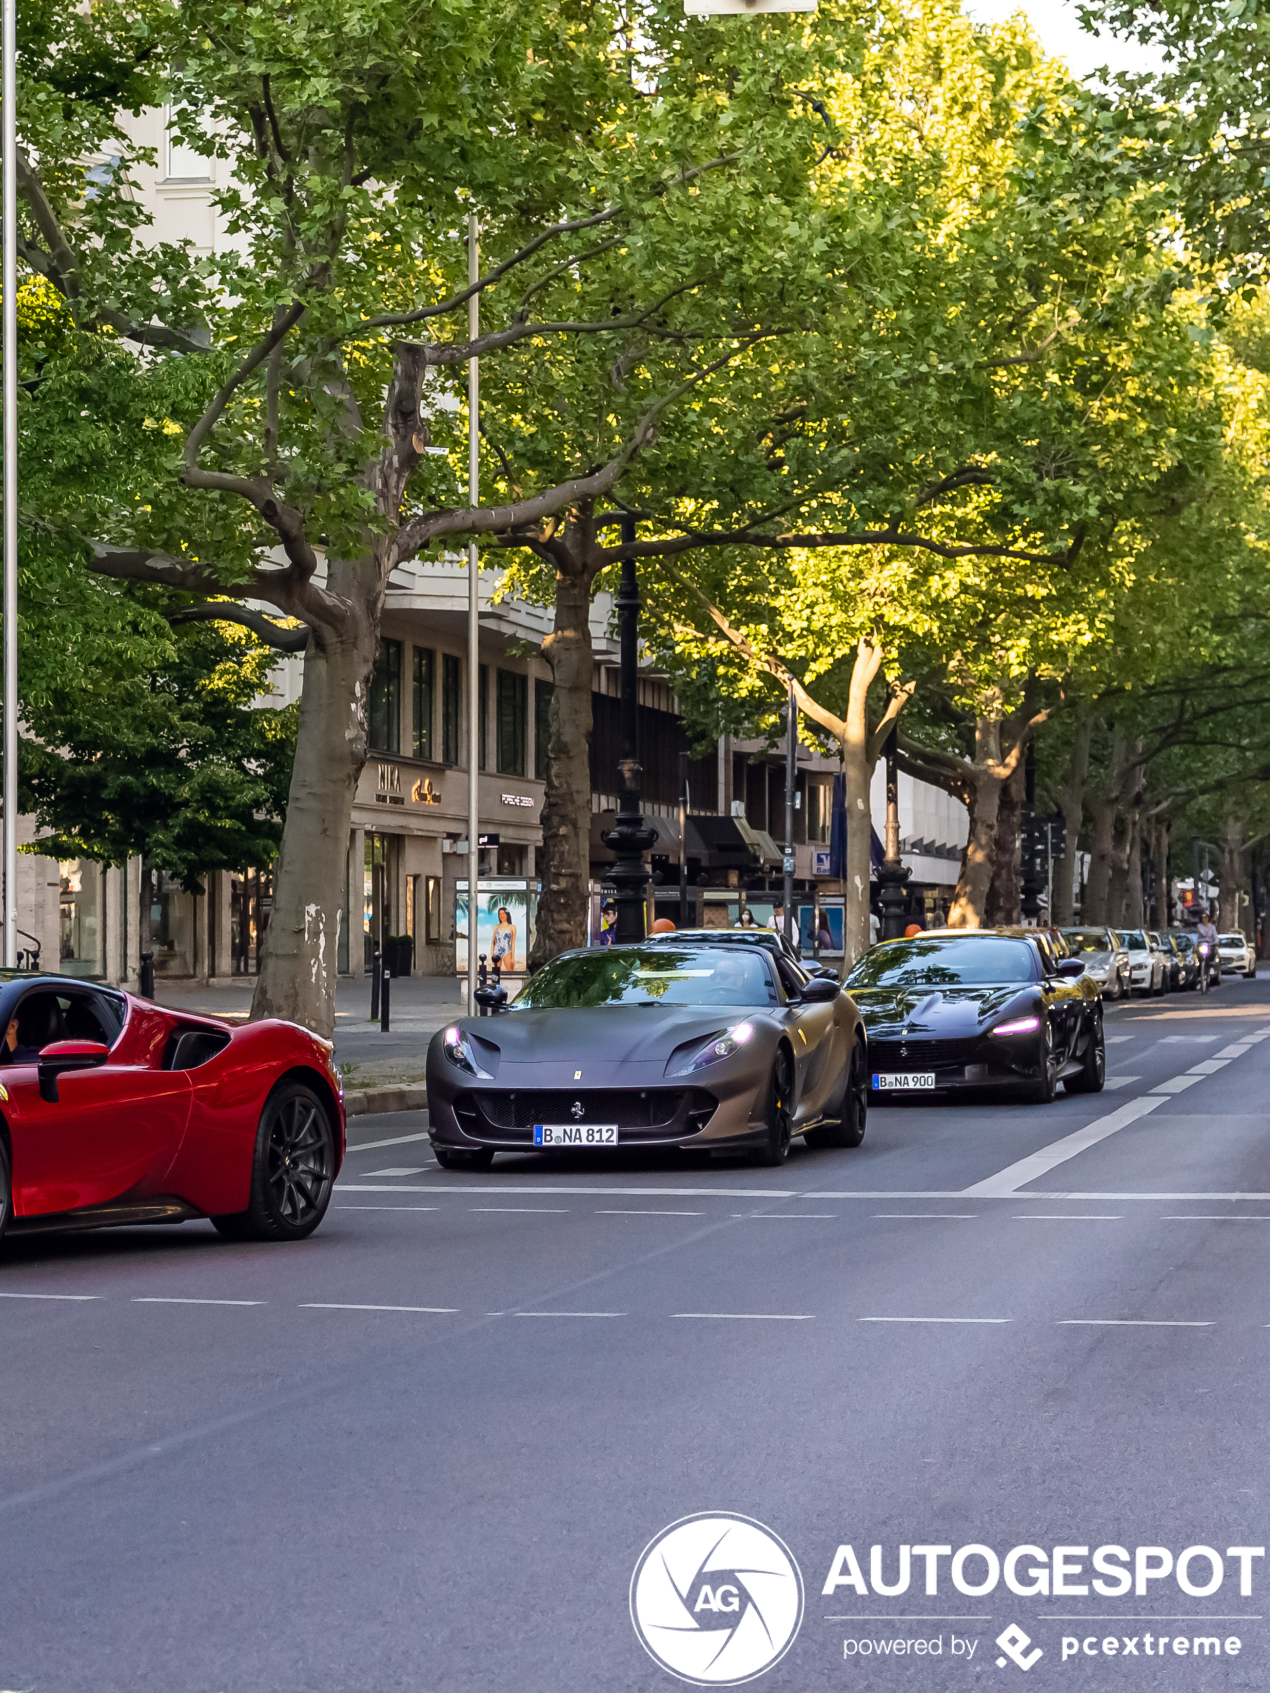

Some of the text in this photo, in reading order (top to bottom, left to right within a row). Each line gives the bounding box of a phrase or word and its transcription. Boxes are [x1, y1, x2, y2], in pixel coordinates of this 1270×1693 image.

[378, 764, 401, 792] NIKA
[880, 1075, 933, 1087] B NA 900
[544, 1128, 553, 1143] B
[563, 1128, 582, 1143] NA
[586, 1128, 615, 1143] 812
